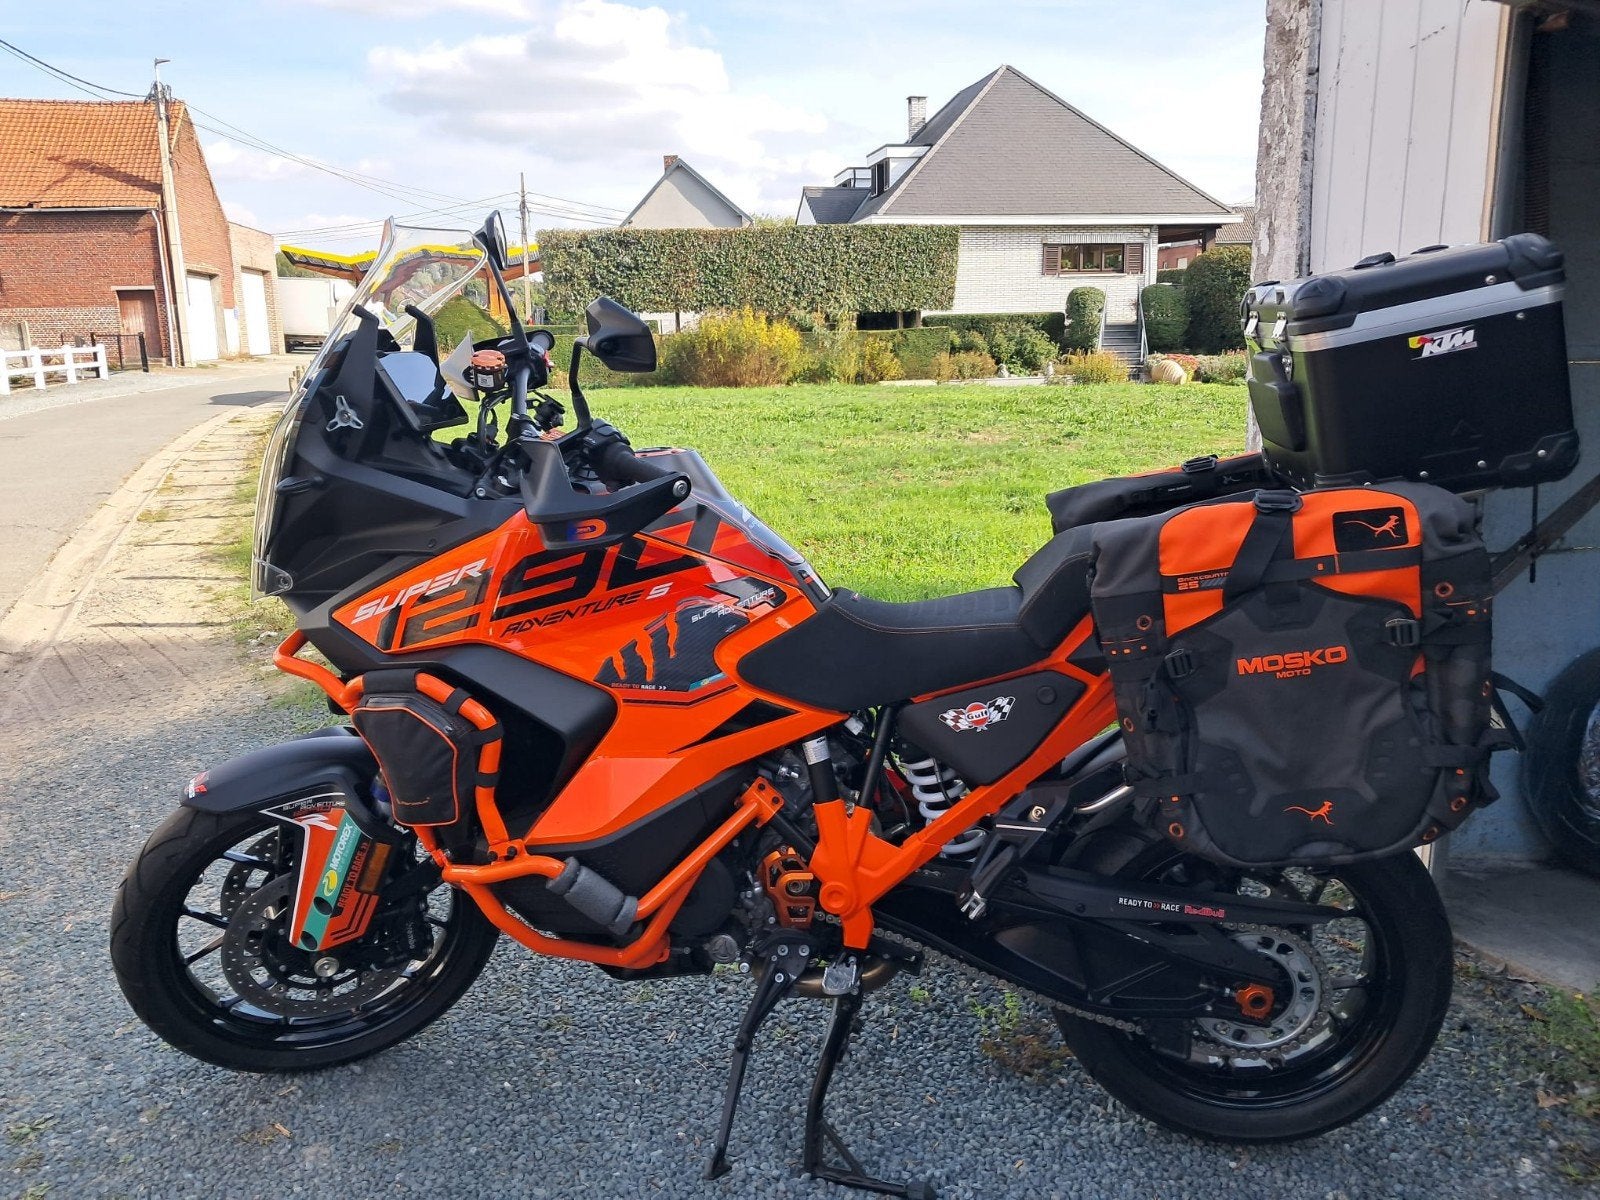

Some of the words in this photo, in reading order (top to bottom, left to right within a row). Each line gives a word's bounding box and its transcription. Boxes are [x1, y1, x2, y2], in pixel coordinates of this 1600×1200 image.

[1422, 329, 1475, 357] KTM
[351, 558, 487, 624] SUPER
[1178, 580, 1199, 590] 25
[500, 588, 647, 637] ADVENTURE
[646, 582, 674, 600] S
[691, 603, 725, 623] SUPER
[1237, 646, 1347, 675] MOSKO
[1276, 668, 1312, 679] MOTO
[966, 710, 989, 720] Gulf
[329, 823, 354, 870] MOTOREX
[337, 882, 353, 908] READY
[351, 850, 366, 872] RACE
[1118, 897, 1143, 908] READY
[1143, 900, 1153, 909] TO
[1160, 903, 1180, 912] RACE
